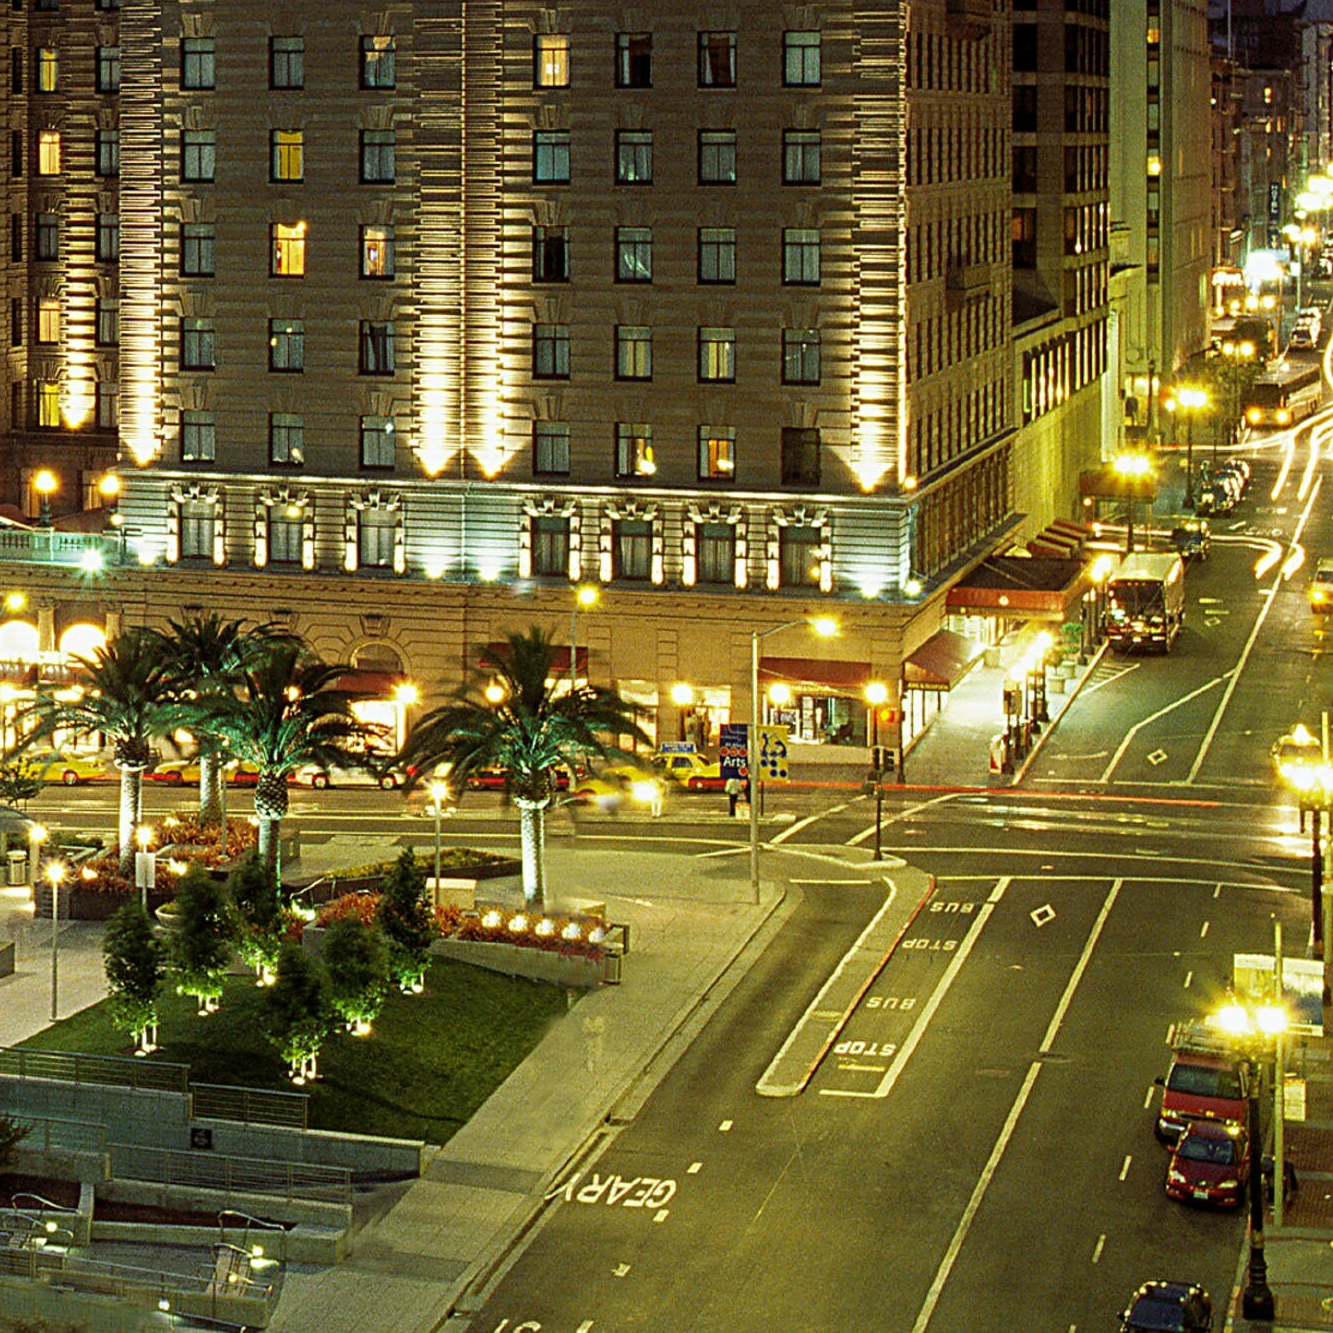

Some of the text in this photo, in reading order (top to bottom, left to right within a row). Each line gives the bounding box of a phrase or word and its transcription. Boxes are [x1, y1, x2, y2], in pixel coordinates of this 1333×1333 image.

[723, 756, 746, 767] Arts
[930, 902, 974, 913] BUS
[902, 939, 957, 951] STOP
[866, 997, 916, 1010] BUS
[833, 1041, 897, 1056] STOP
[544, 1173, 676, 1208] GEARY
